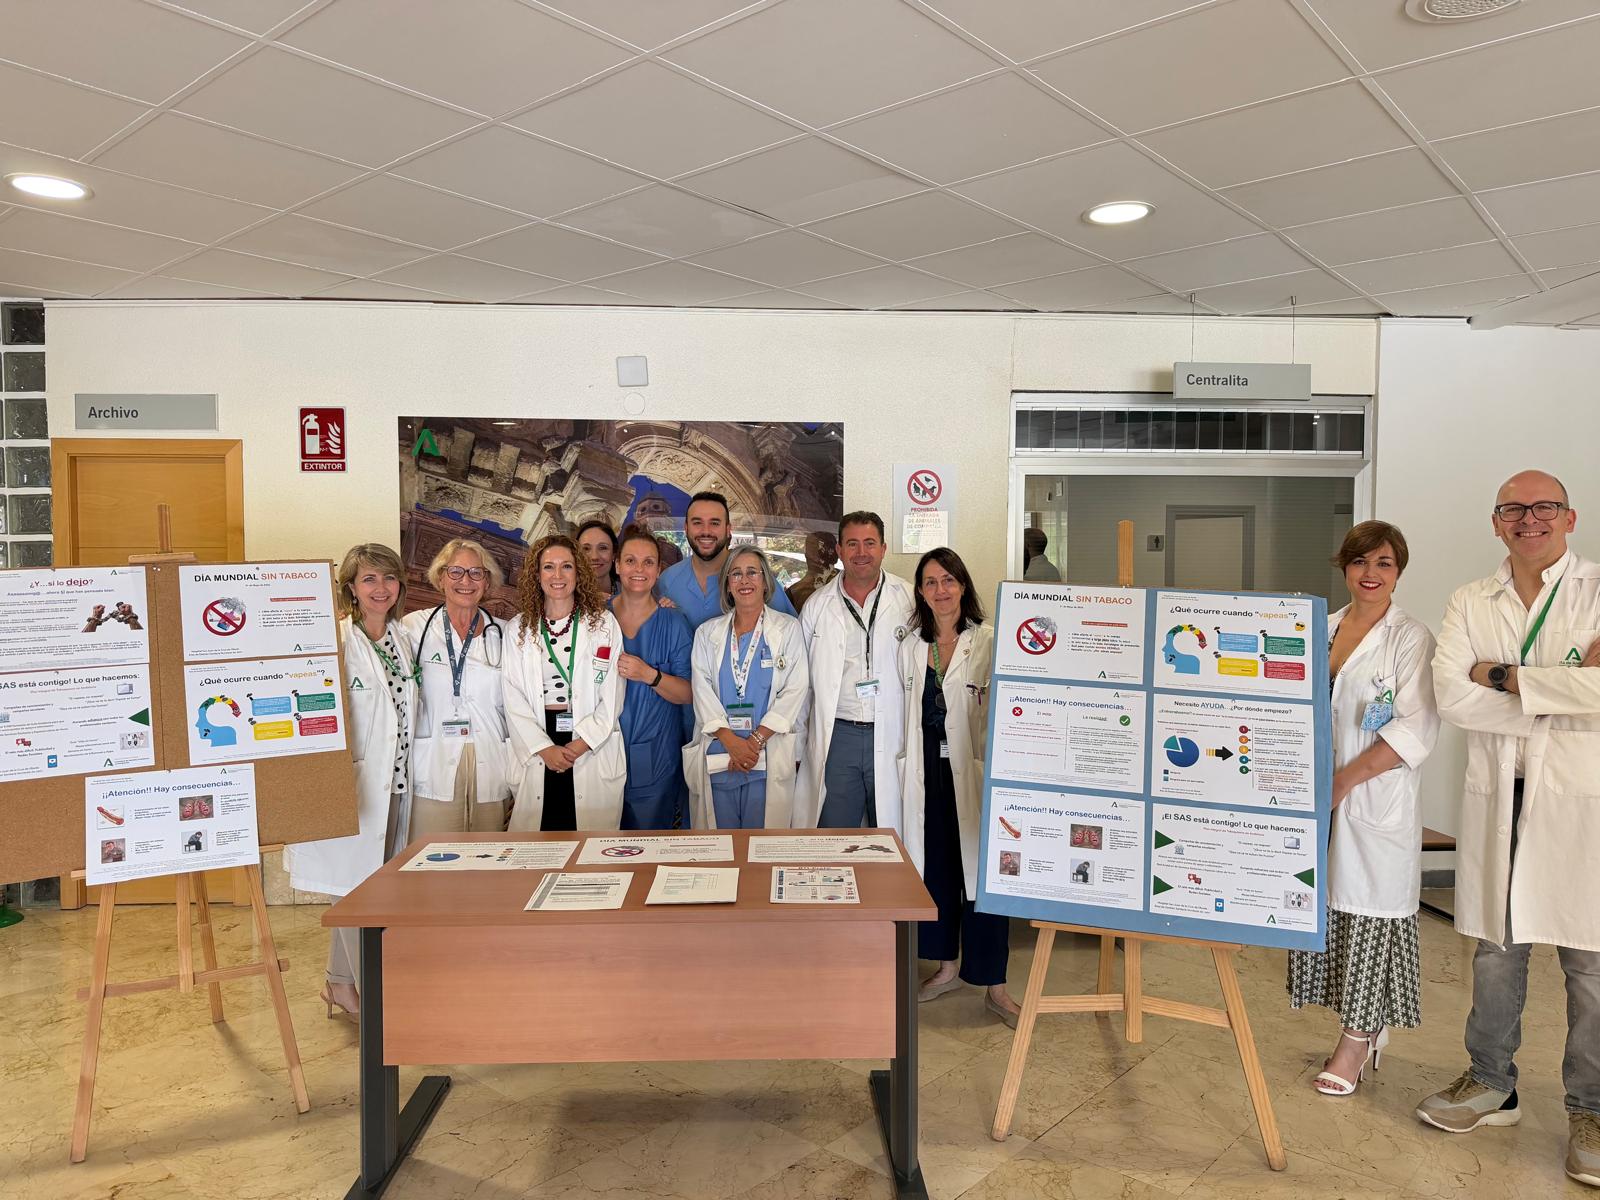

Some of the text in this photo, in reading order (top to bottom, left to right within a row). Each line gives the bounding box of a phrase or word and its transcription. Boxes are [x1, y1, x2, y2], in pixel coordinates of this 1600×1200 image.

[1186, 374, 1248, 386] Centralita
[88, 406, 138, 419] Archivo
[66, 578, 94, 587] dejo?
[194, 573, 211, 582] DÍA
[214, 573, 259, 581] MUNDIAL
[280, 572, 318, 580] TABACO
[1014, 592, 1029, 600] DÍA
[1032, 593, 1073, 602] MUNDIAL
[1094, 596, 1132, 605] TABACO
[1170, 606, 1191, 614] ¿Qué
[1222, 609, 1253, 617] cuando
[39, 678, 72, 688] contigo!
[85, 677, 100, 685] que
[200, 675, 221, 686] ¿Qué
[1009, 696, 1051, 704] ¡¡Atención!!
[1053, 698, 1067, 706] Hay
[102, 787, 152, 799] ¡¡Atención!!
[154, 786, 170, 794] Hay
[1004, 804, 1047, 814] ¡¡Atención!!
[1049, 808, 1063, 817] Hay
[1174, 813, 1192, 822] SAS
[1211, 818, 1241, 828] contigo!
[1254, 823, 1268, 831] que
[1270, 824, 1308, 834] hacemos:
